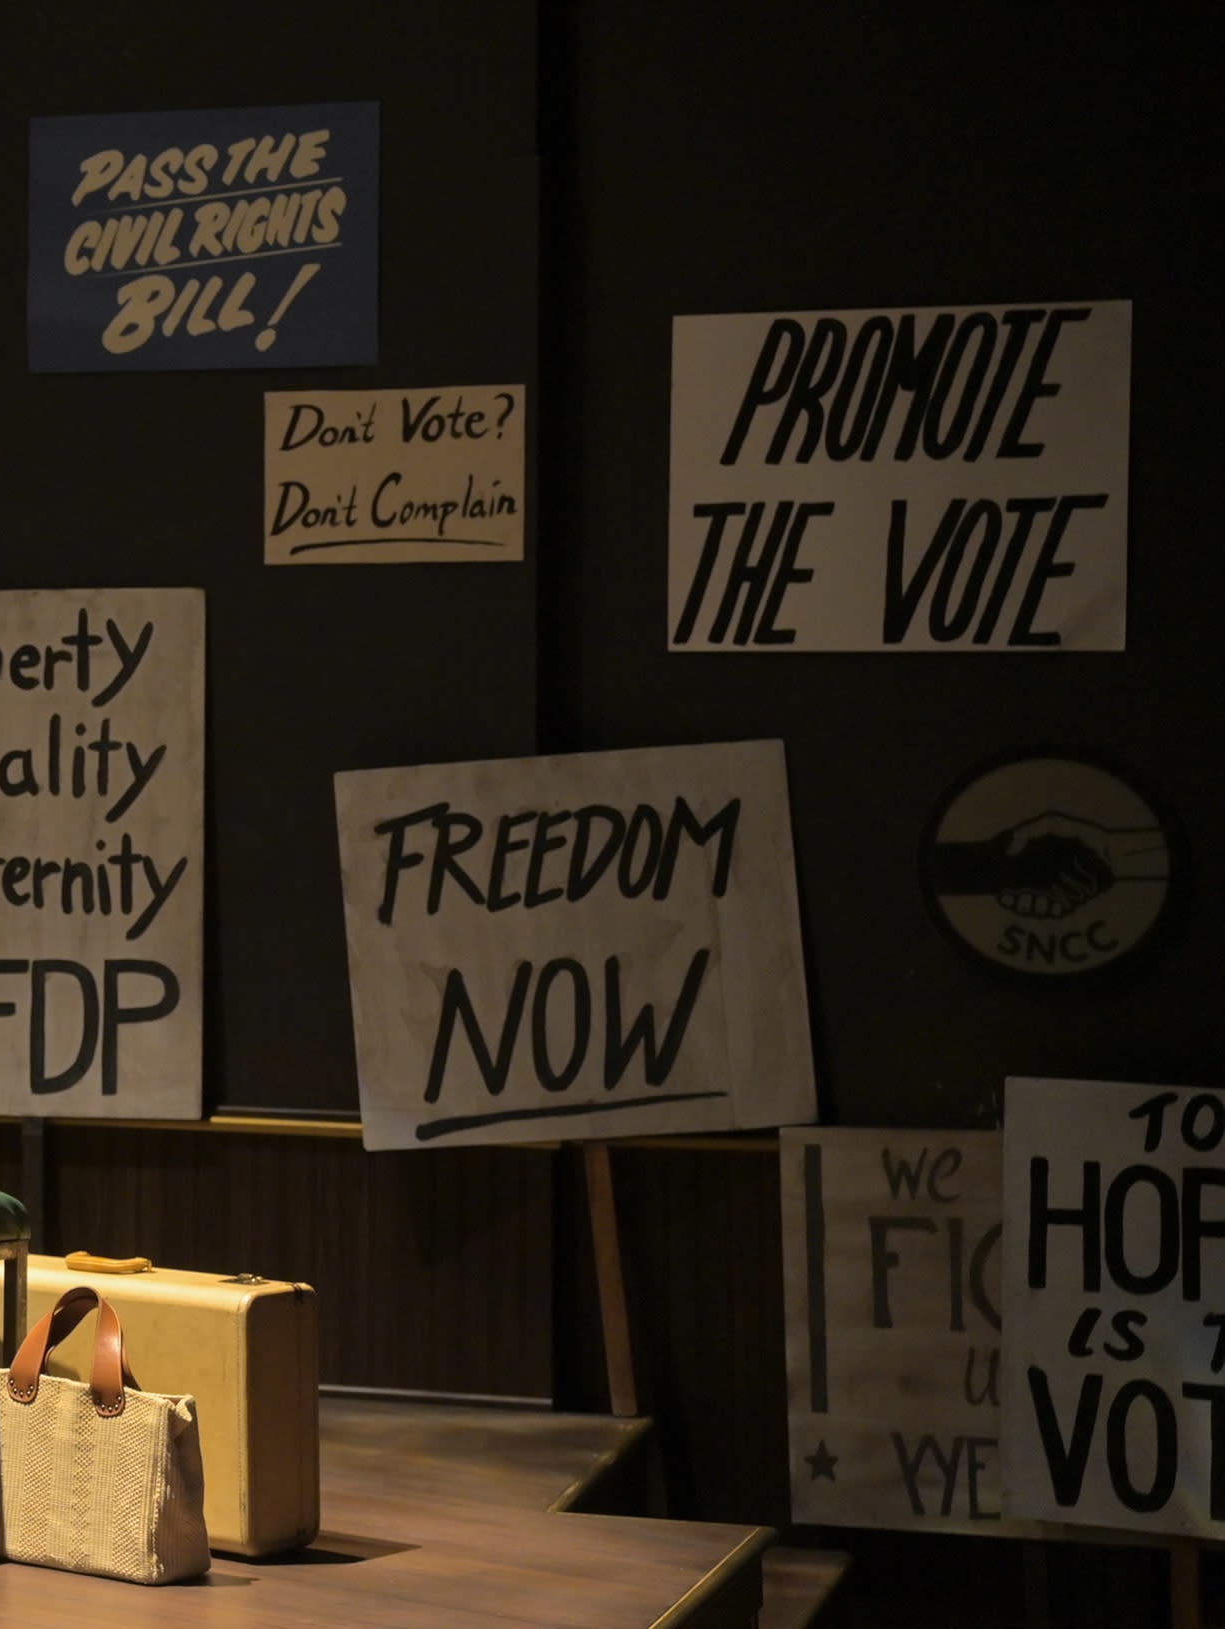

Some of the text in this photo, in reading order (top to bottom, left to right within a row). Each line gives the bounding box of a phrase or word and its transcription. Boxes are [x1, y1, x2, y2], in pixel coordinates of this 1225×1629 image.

[72, 129, 331, 207] PASS THE
[64, 186, 347, 276] CIVIL RIGHTS
[102, 263, 320, 354] BILL!
[280, 393, 515, 450] Don't Vote?
[720, 308, 1092, 465] PROMOTE
[271, 473, 517, 536] Don't Complain
[673, 494, 1109, 646] THE VOTE
[375, 796, 741, 925] FREEDOM
[998, 920, 1119, 965] SNCC
[424, 949, 710, 1104] NOW
[1129, 1092, 1225, 1152] TO
